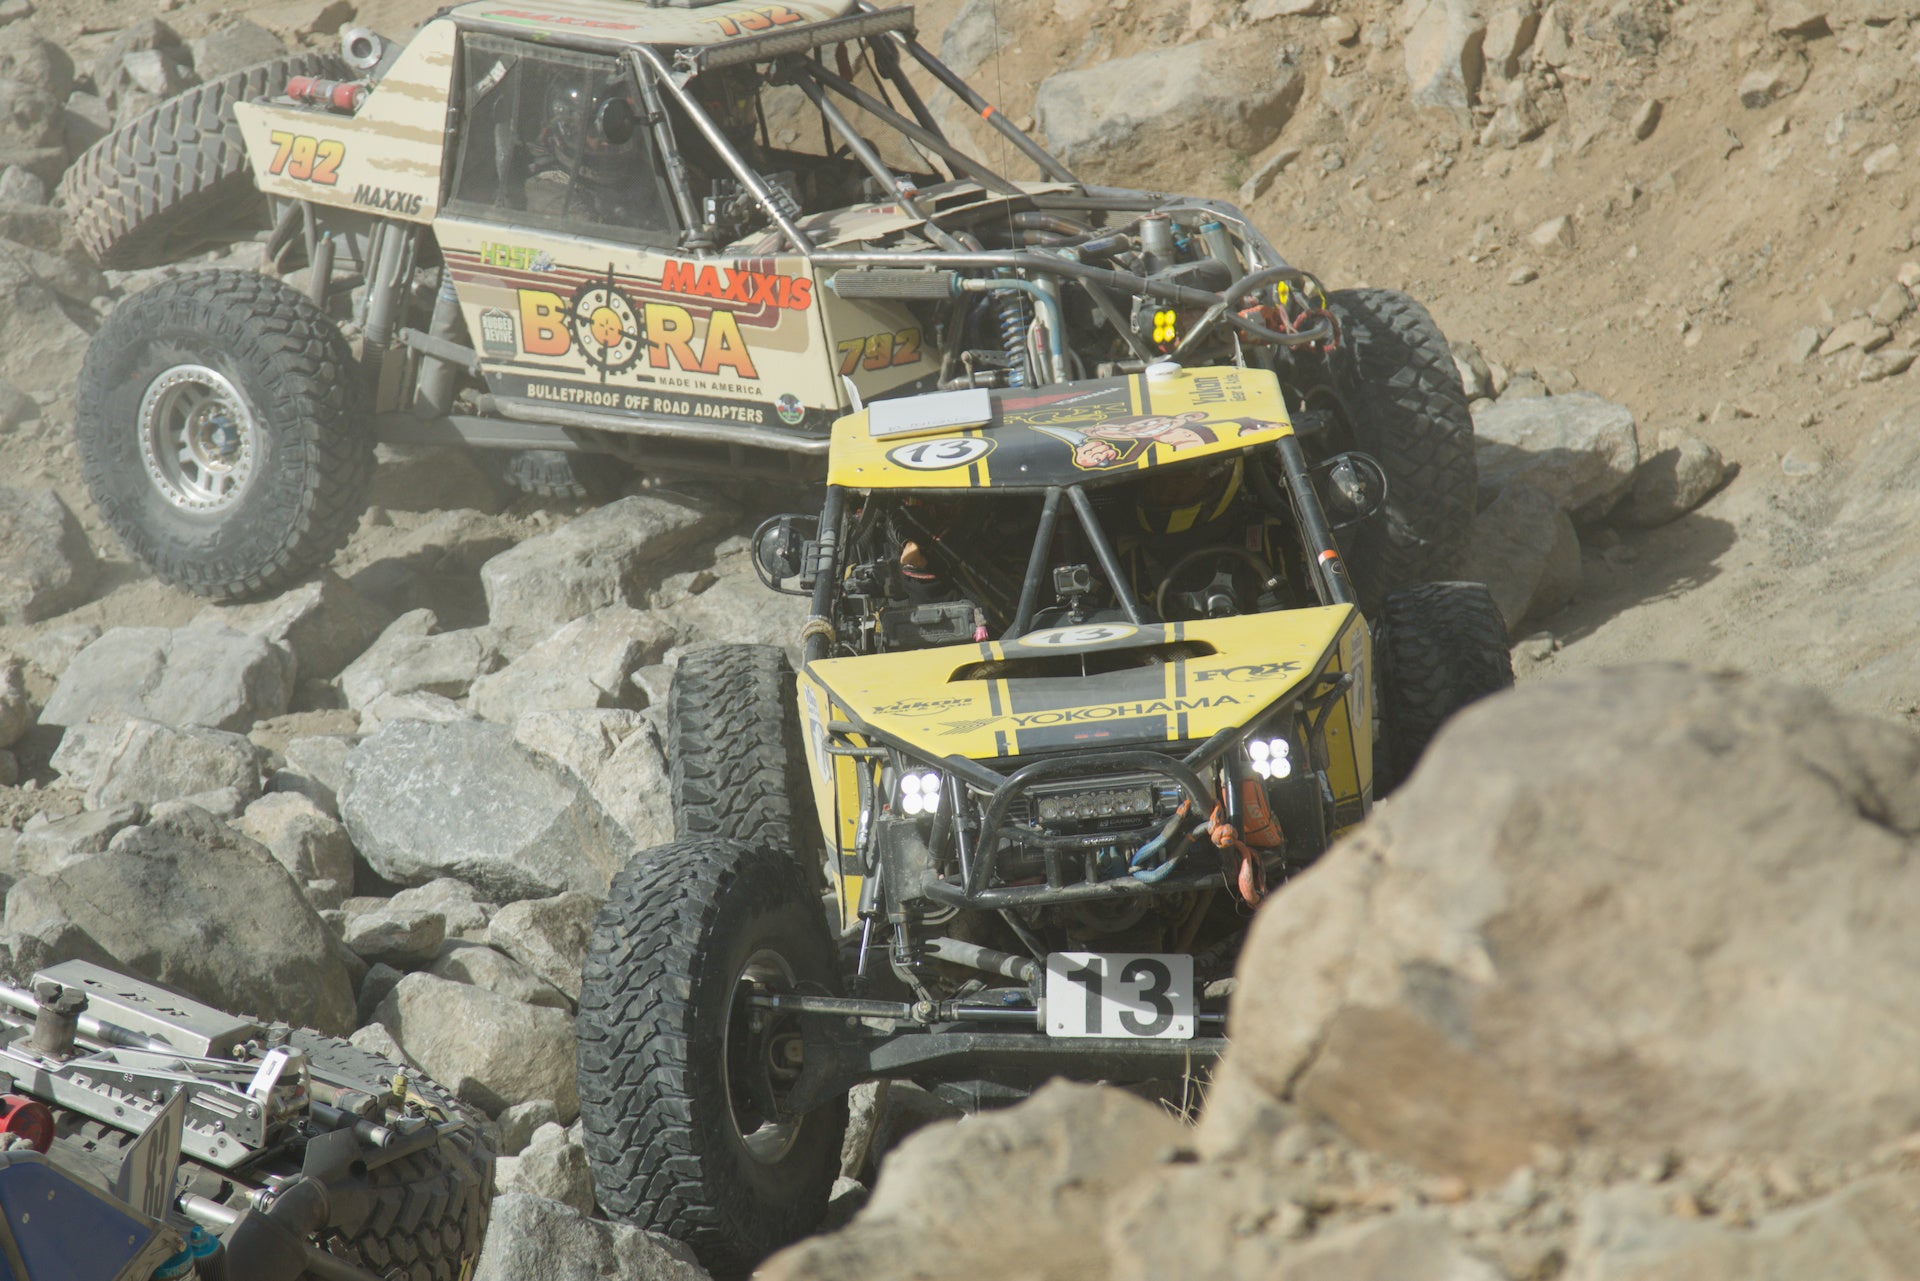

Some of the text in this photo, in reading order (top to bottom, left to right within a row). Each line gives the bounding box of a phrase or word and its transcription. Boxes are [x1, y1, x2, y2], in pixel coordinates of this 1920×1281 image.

[701, 6, 805, 37] 792
[269, 129, 346, 186] 792
[353, 184, 423, 215] MAXXIS
[661, 259, 813, 311] MAXXIS
[482, 315, 513, 331] RUGGED
[484, 329, 514, 344] REVIVE
[517, 278, 761, 382] BORA
[836, 327, 922, 378] 792
[659, 376, 763, 396] MADE IN AMERICA
[527, 383, 620, 407] BULLETPROOF
[624, 393, 650, 410] OFF
[653, 398, 690, 415] ROAD
[693, 402, 764, 423] ADAPTERS
[904, 439, 973, 463] 13
[1042, 626, 1117, 644] 13
[1193, 660, 1302, 683] FOX
[1011, 694, 1240, 727] YOKOHAMA
[1066, 957, 1175, 1037] 13
